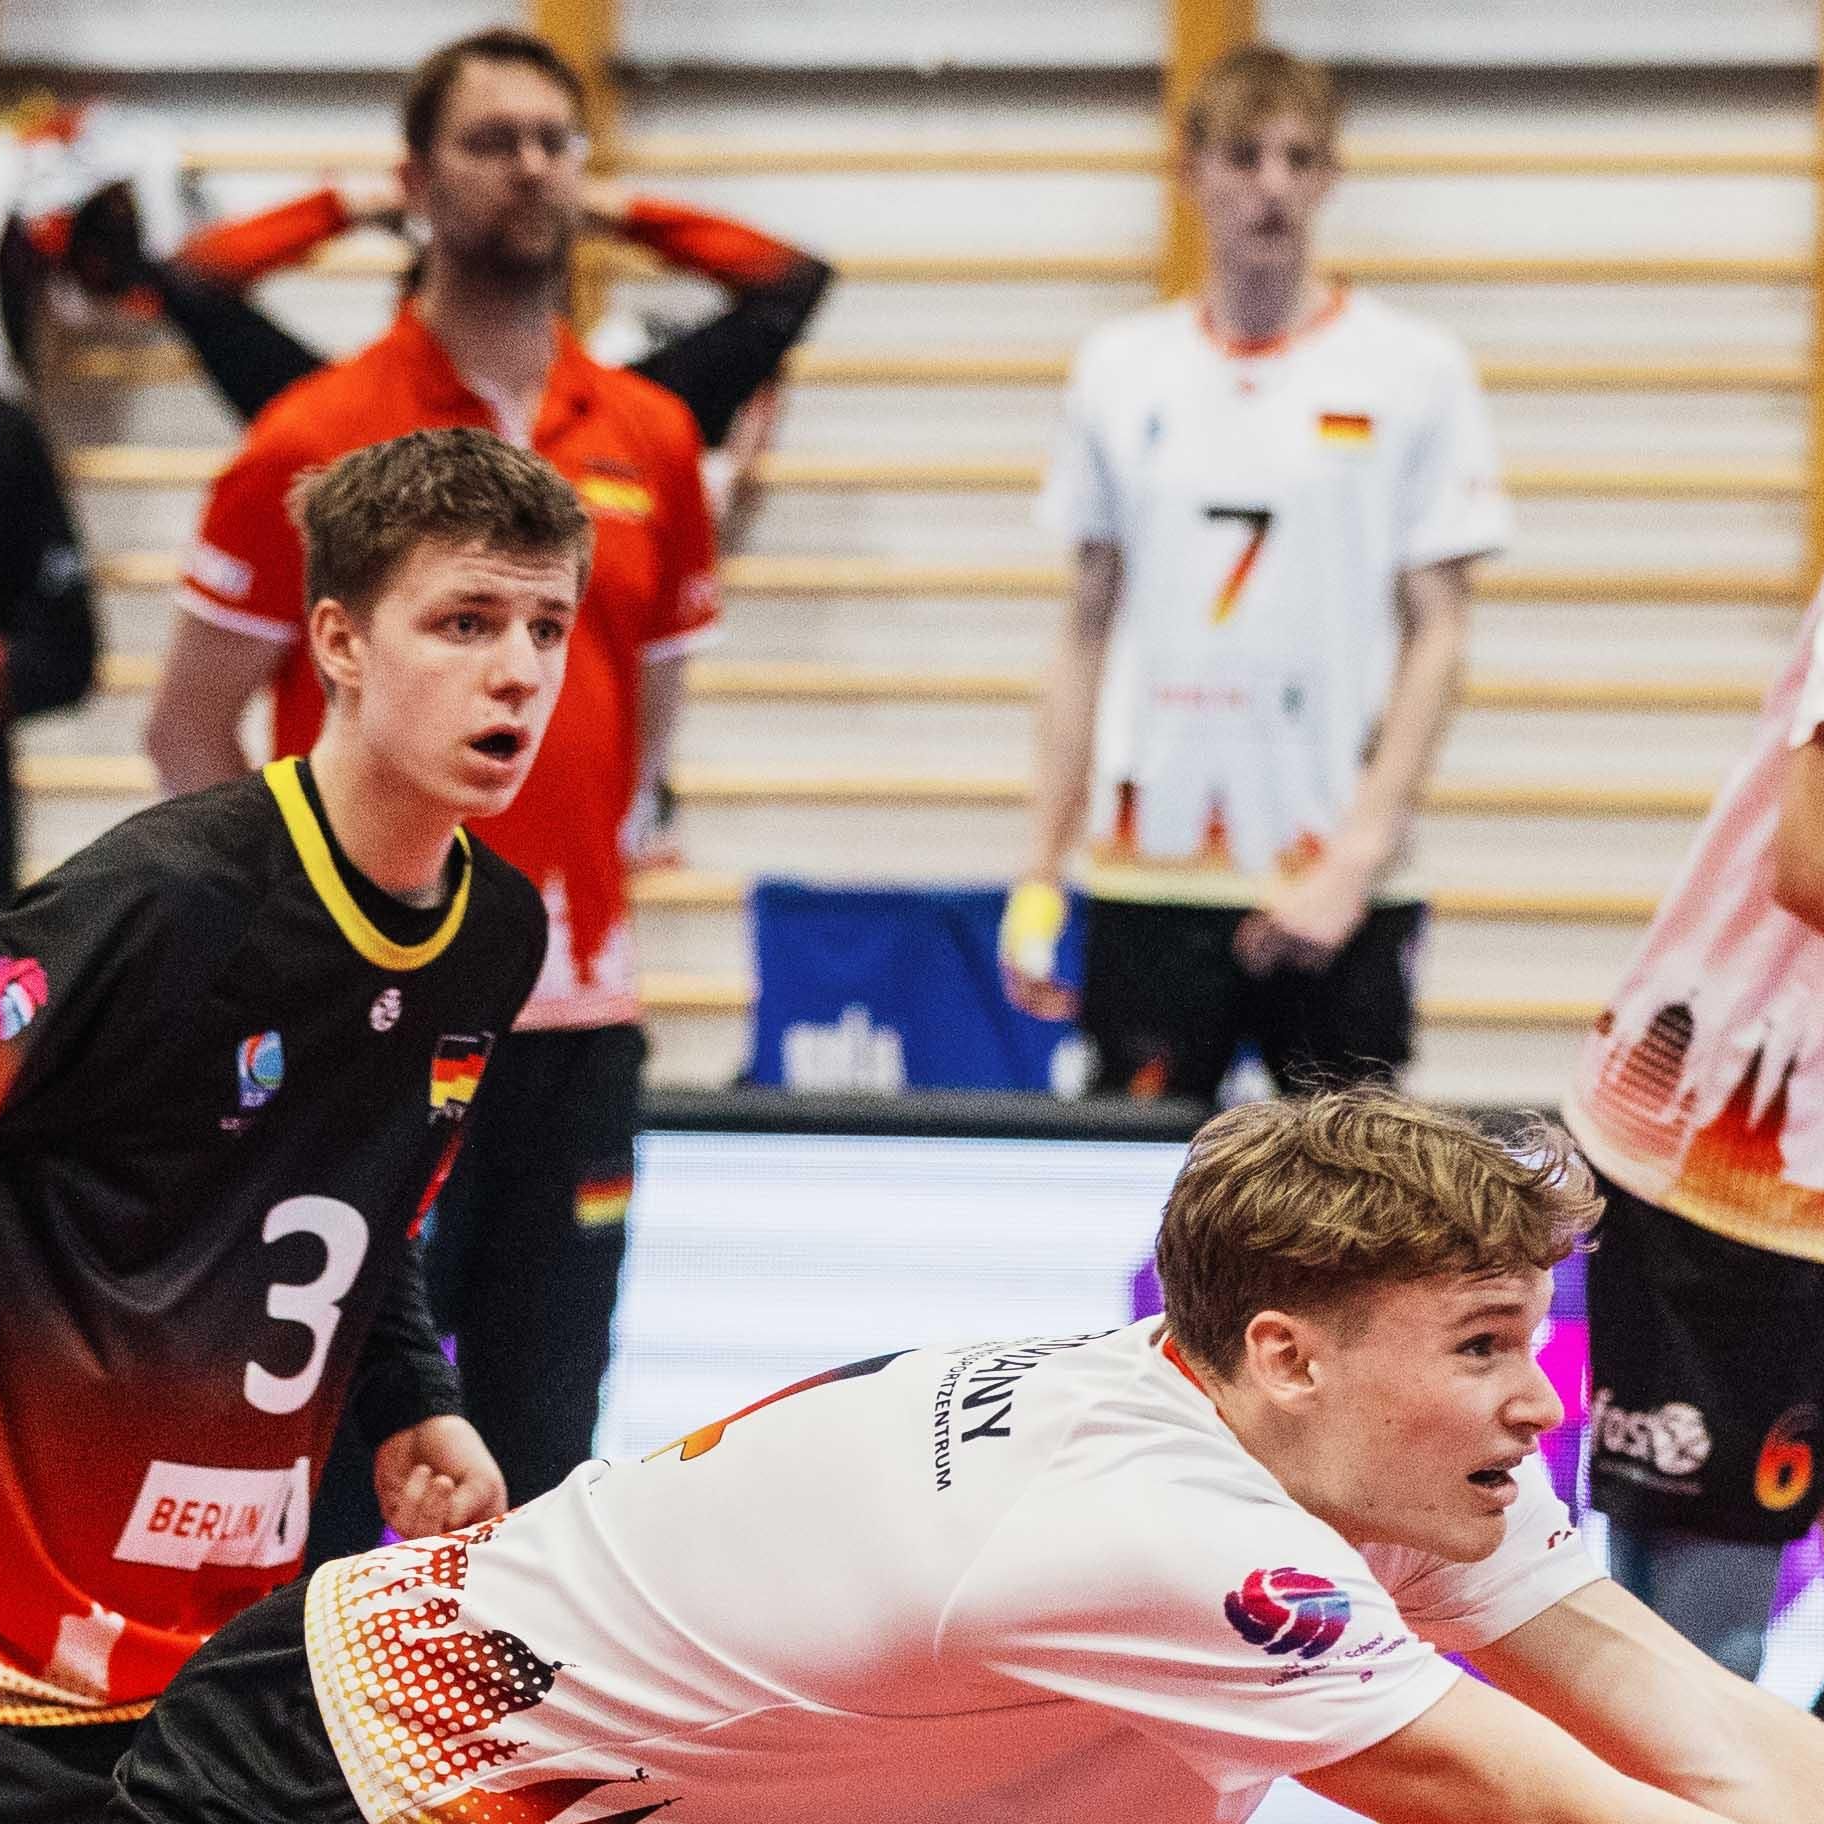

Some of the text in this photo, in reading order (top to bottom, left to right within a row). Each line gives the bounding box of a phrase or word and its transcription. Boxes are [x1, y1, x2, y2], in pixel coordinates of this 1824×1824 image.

[1205, 508, 1272, 626] 7
[243, 1195, 369, 1415] 3
[1755, 1402, 1822, 1510] 6
